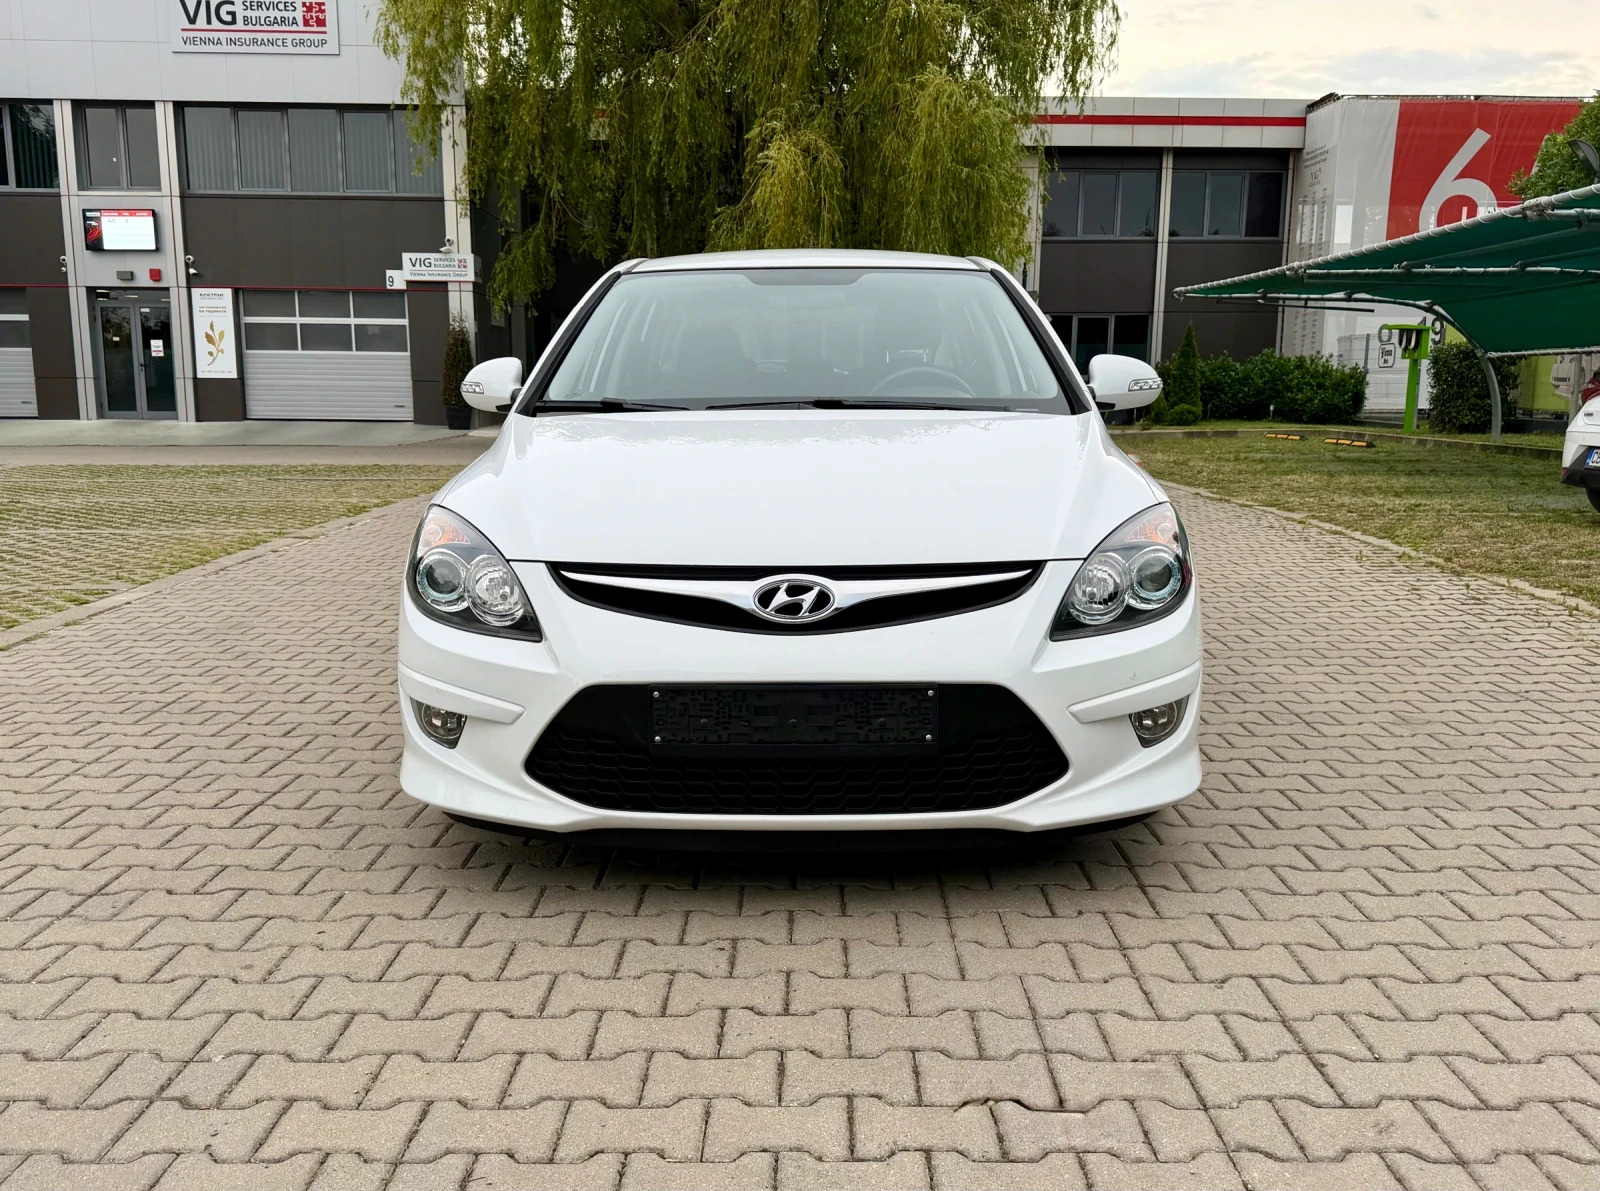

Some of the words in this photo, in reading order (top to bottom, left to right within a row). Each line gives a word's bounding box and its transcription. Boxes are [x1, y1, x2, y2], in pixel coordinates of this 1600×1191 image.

[242, 0, 297, 12] SERVICES
[179, 0, 238, 26] VIG
[242, 15, 299, 27] BULGARIA
[181, 36, 223, 47] VIENNA
[225, 37, 288, 48] INSURANCE
[291, 38, 328, 48] GROUP
[1418, 127, 1499, 234] 6
[409, 257, 432, 268] VIG
[388, 276, 394, 287] 9
